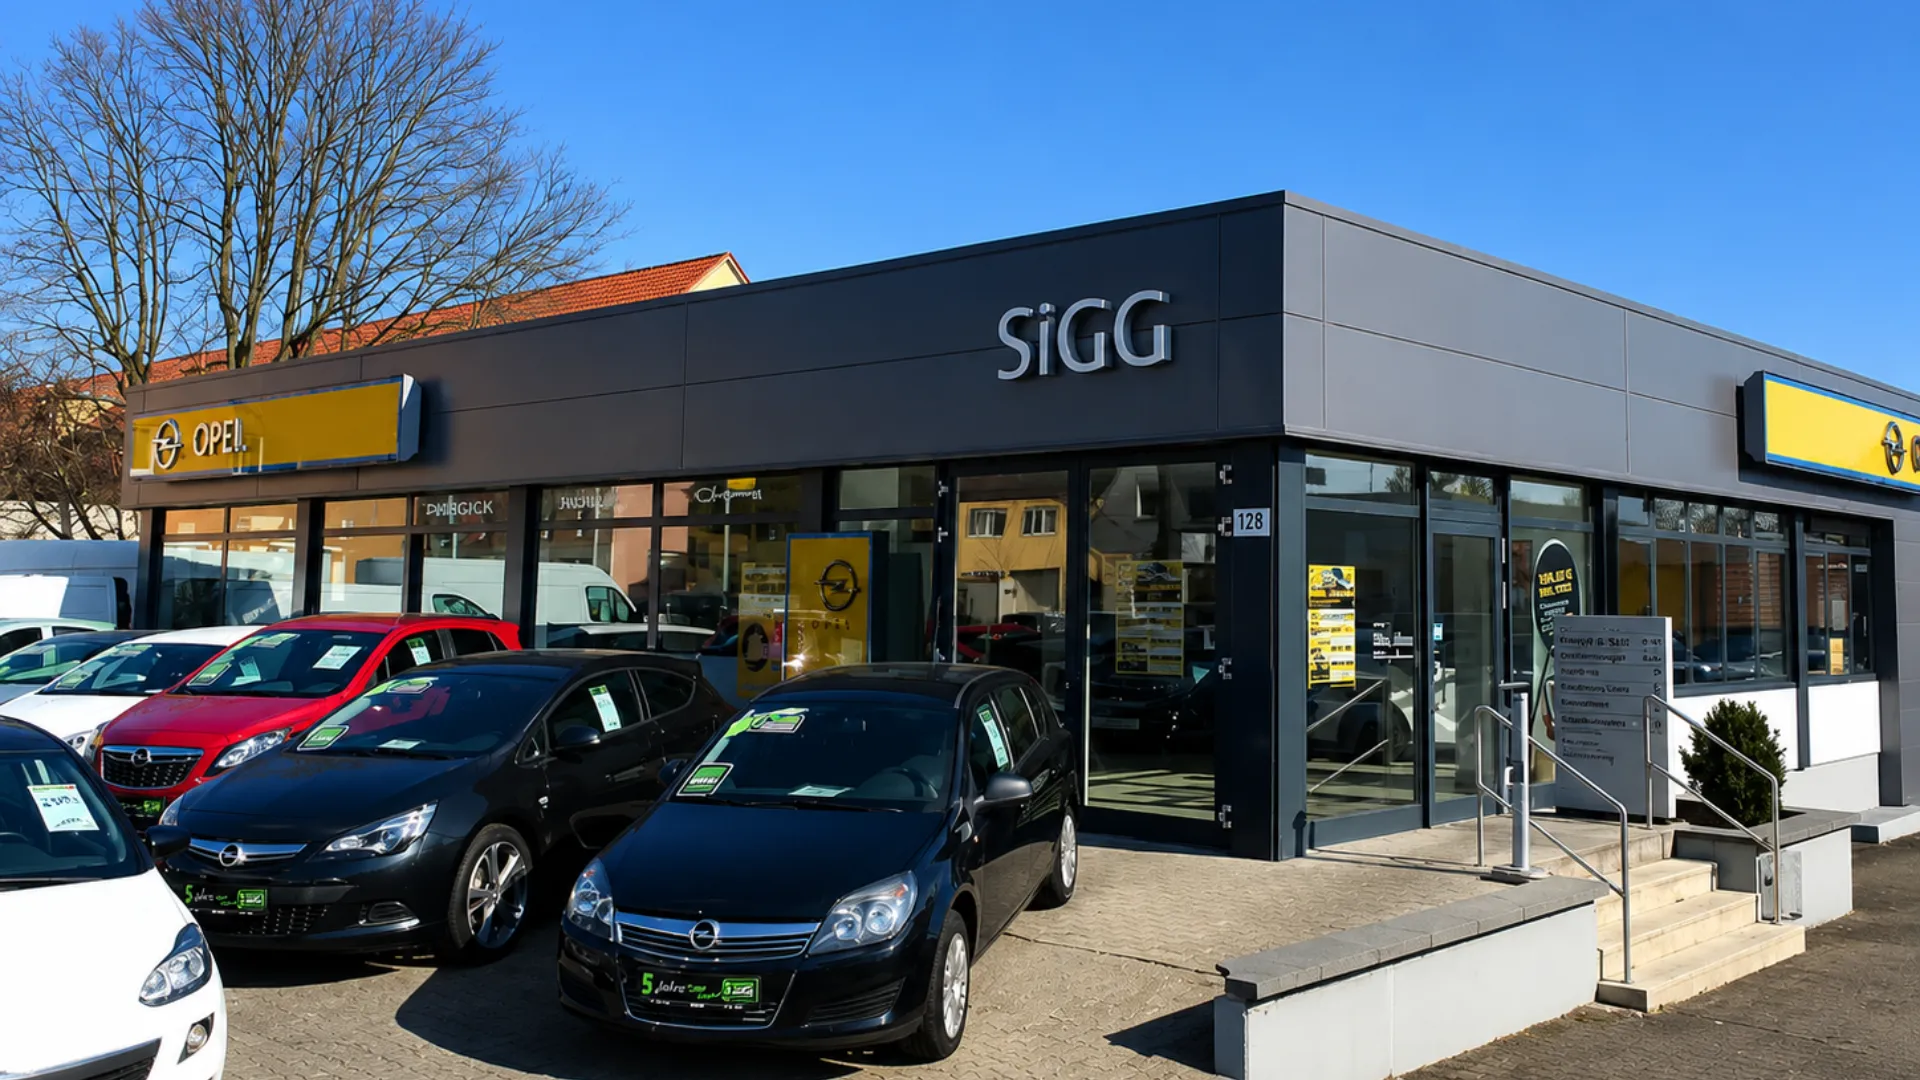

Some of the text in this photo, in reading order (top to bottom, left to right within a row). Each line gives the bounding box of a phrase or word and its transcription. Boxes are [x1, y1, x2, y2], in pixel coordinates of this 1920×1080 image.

[998, 289, 1172, 380] SiGG
[1238, 511, 1263, 530] 128
[641, 972, 654, 994] 5
